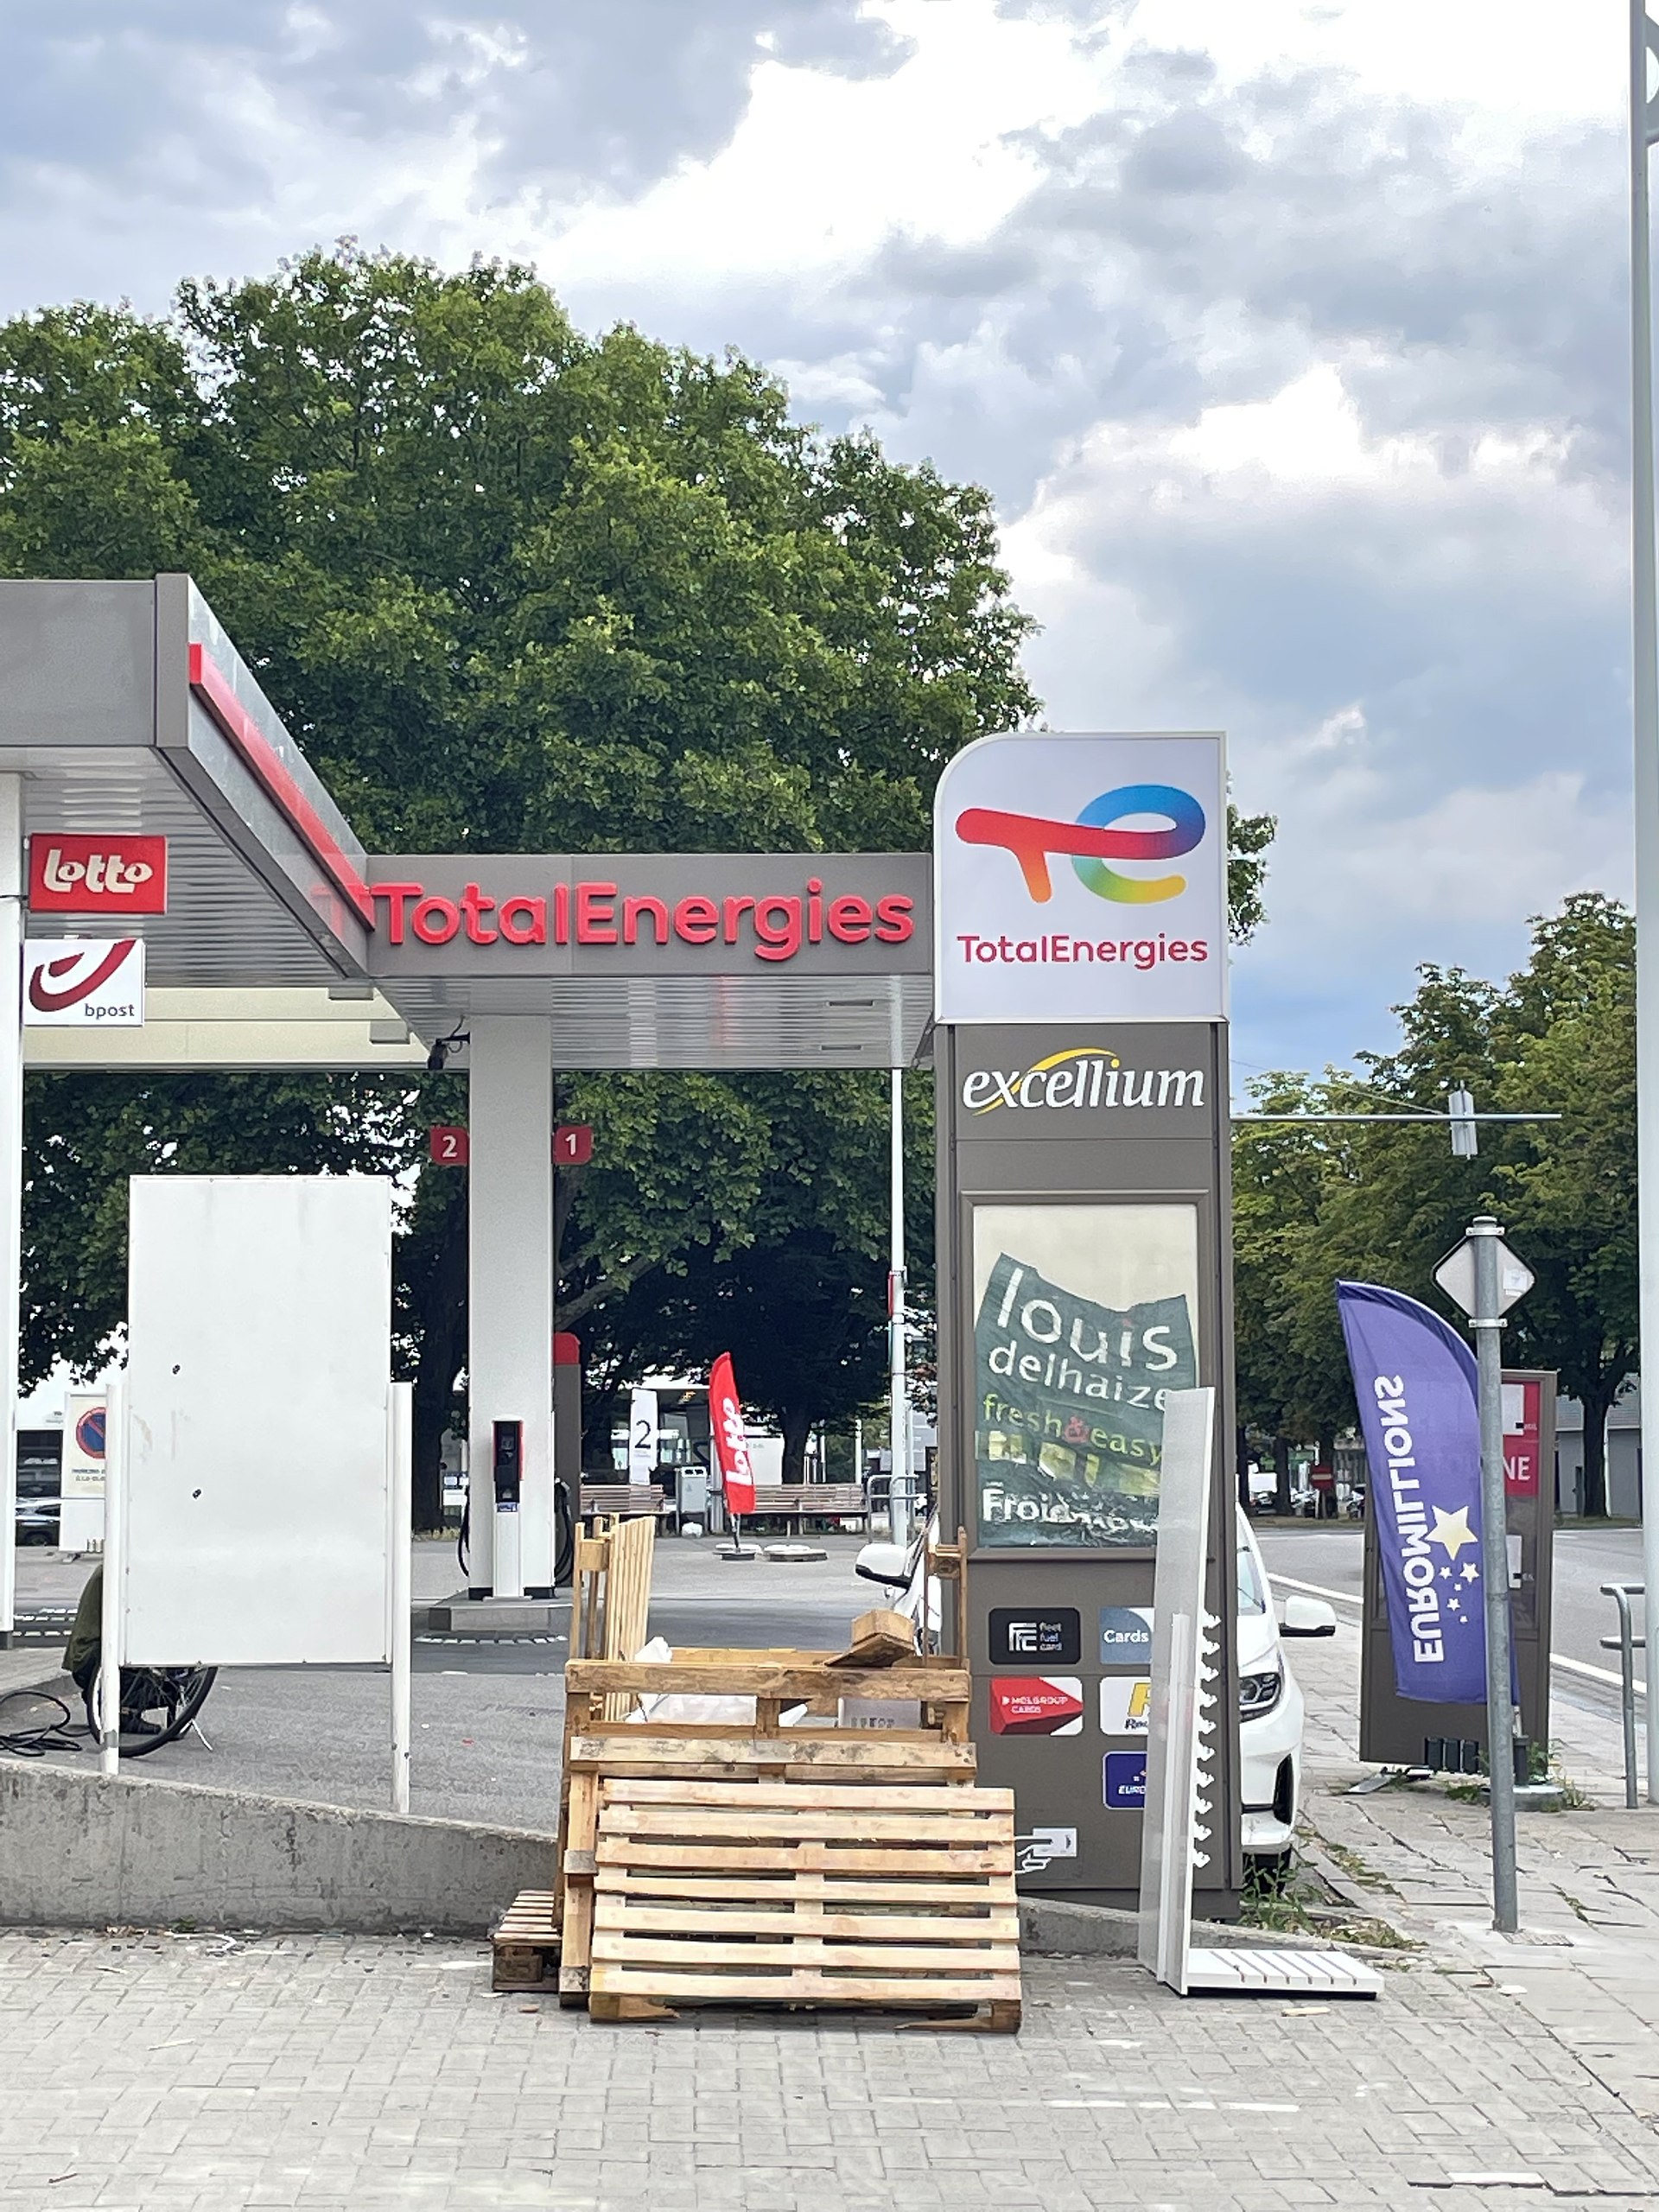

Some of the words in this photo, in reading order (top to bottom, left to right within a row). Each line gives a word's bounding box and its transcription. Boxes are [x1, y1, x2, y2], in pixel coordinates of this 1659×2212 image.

[369, 878, 916, 961] TotalEnergies
[957, 933, 1208, 970] TotalEnergies
[85, 1003, 135, 1020] bpost
[962, 1056, 1205, 1109] excellium
[442, 1135, 458, 1158] 2
[565, 1134, 577, 1156] 1
[997, 1268, 1178, 1370] louis
[988, 1341, 1174, 1412] delhaize
[634, 1420, 652, 1449] 2
[1503, 1456, 1531, 1480] NE
[1103, 1630, 1149, 1643] Cards
[1118, 1785, 1147, 1795] EURO
